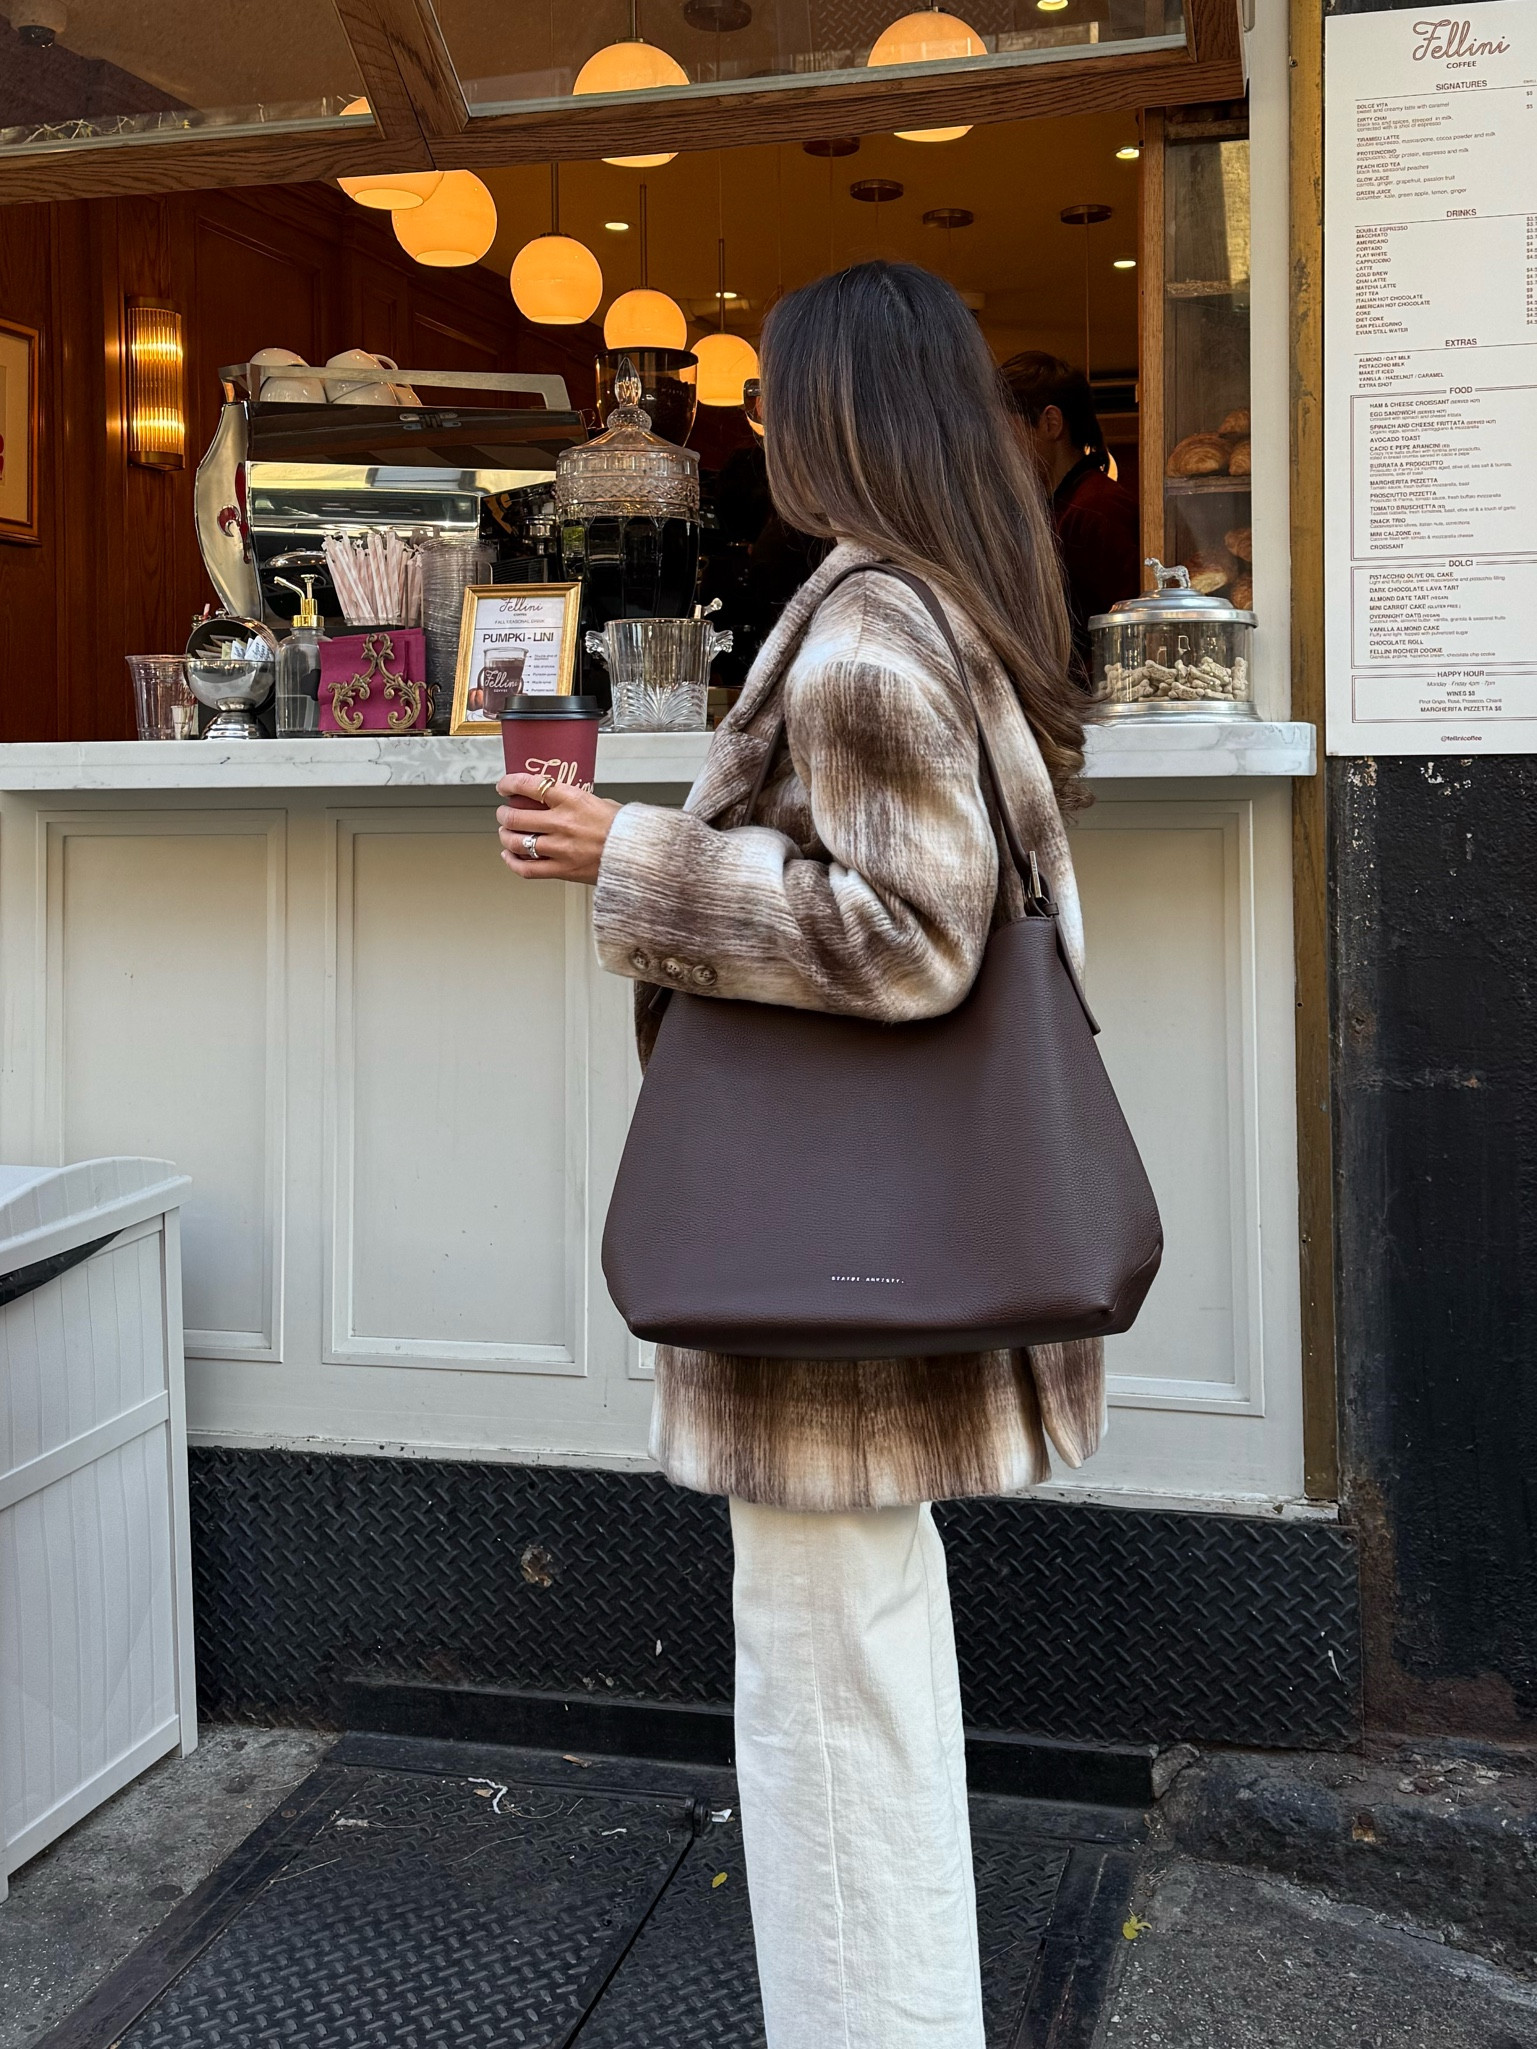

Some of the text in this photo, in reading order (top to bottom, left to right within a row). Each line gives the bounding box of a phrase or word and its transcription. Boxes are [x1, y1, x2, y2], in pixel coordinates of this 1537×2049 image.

[1413, 19, 1510, 61] Fellini
[1446, 61, 1477, 69] COFFEE
[1436, 80, 1488, 91] SIGNATURES
[1446, 208, 1476, 217] DRINKS
[1445, 338, 1477, 346] EXTRAS
[500, 597, 543, 612] Fellini
[483, 632, 526, 643] PUMPKI
[533, 632, 554, 642] LINI
